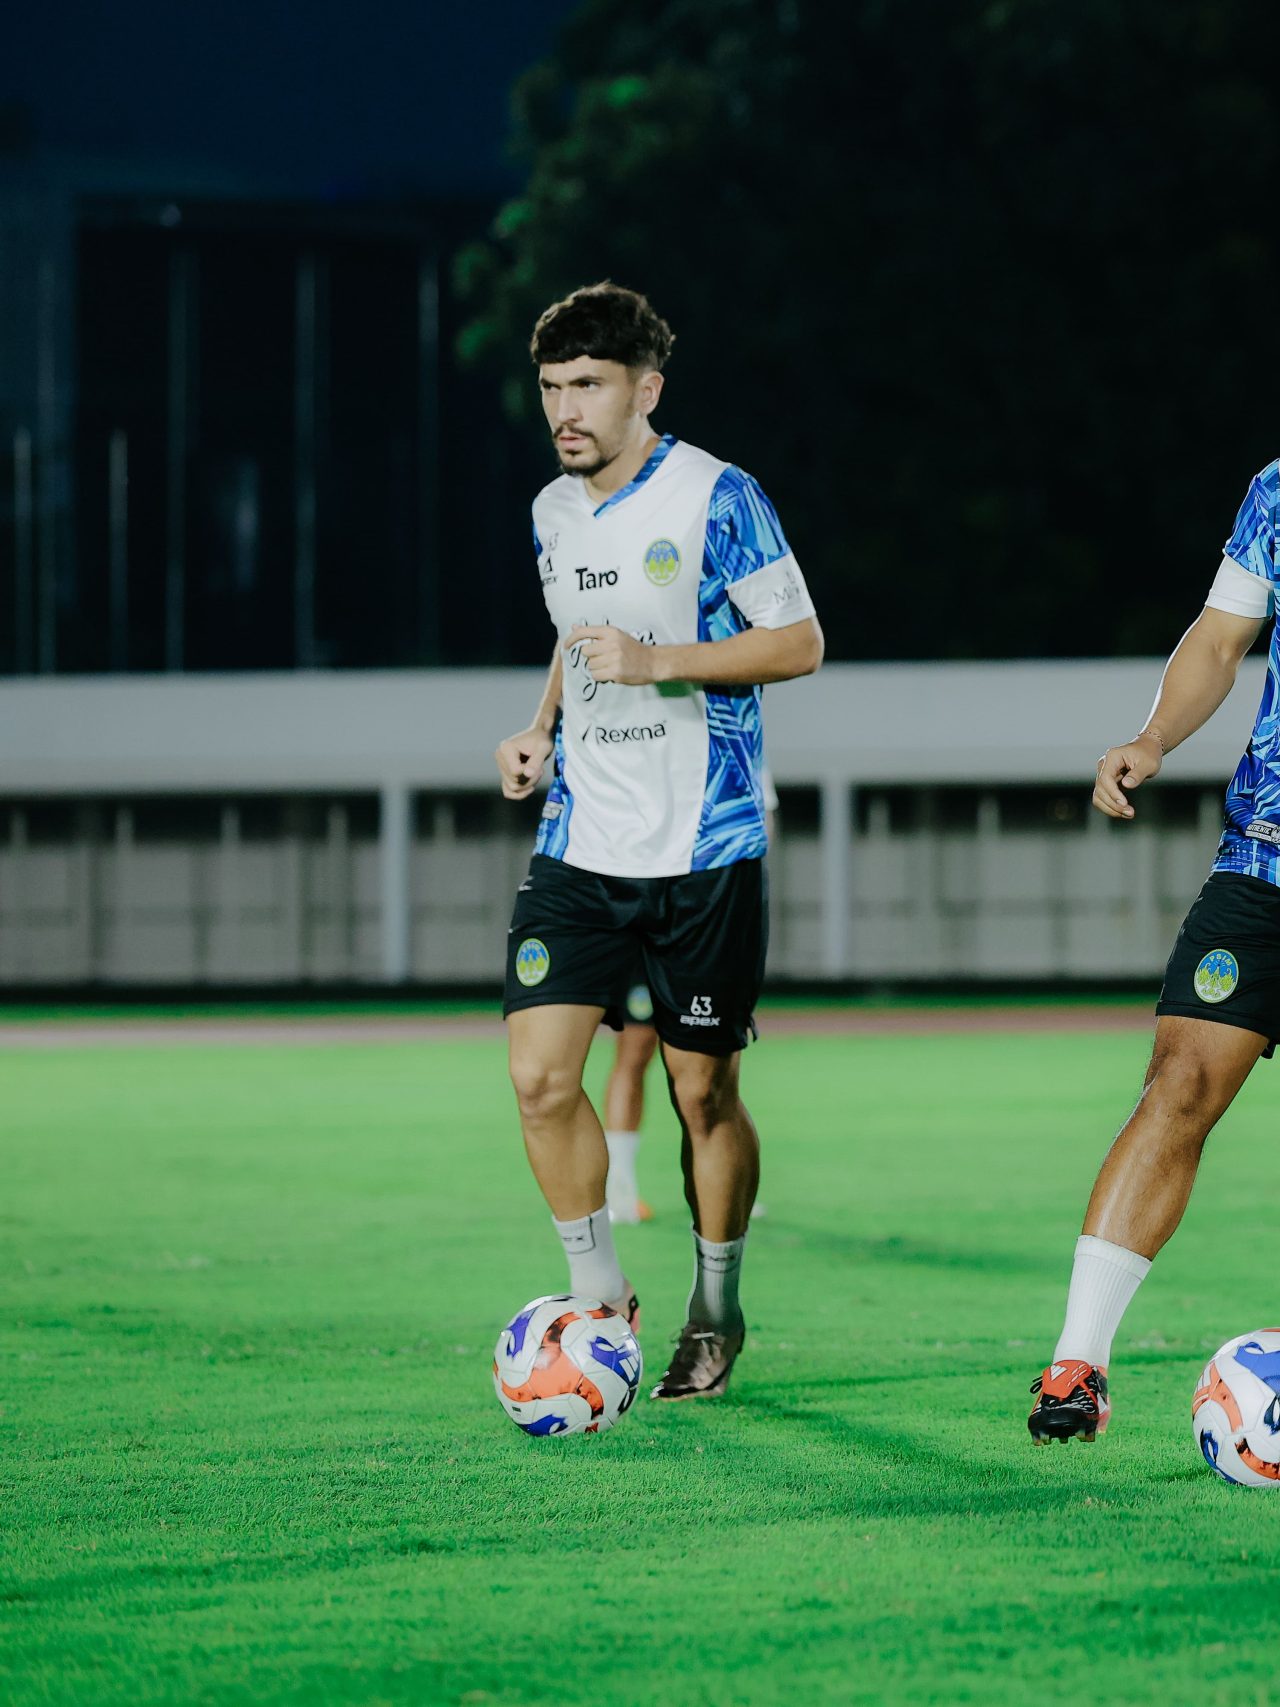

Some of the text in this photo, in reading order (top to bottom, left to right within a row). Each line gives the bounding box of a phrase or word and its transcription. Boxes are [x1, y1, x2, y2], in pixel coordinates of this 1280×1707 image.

[575, 567, 618, 591] Taro
[595, 723, 666, 745] Rexona
[690, 995, 713, 1016] 63
[680, 1013, 721, 1027] apex
